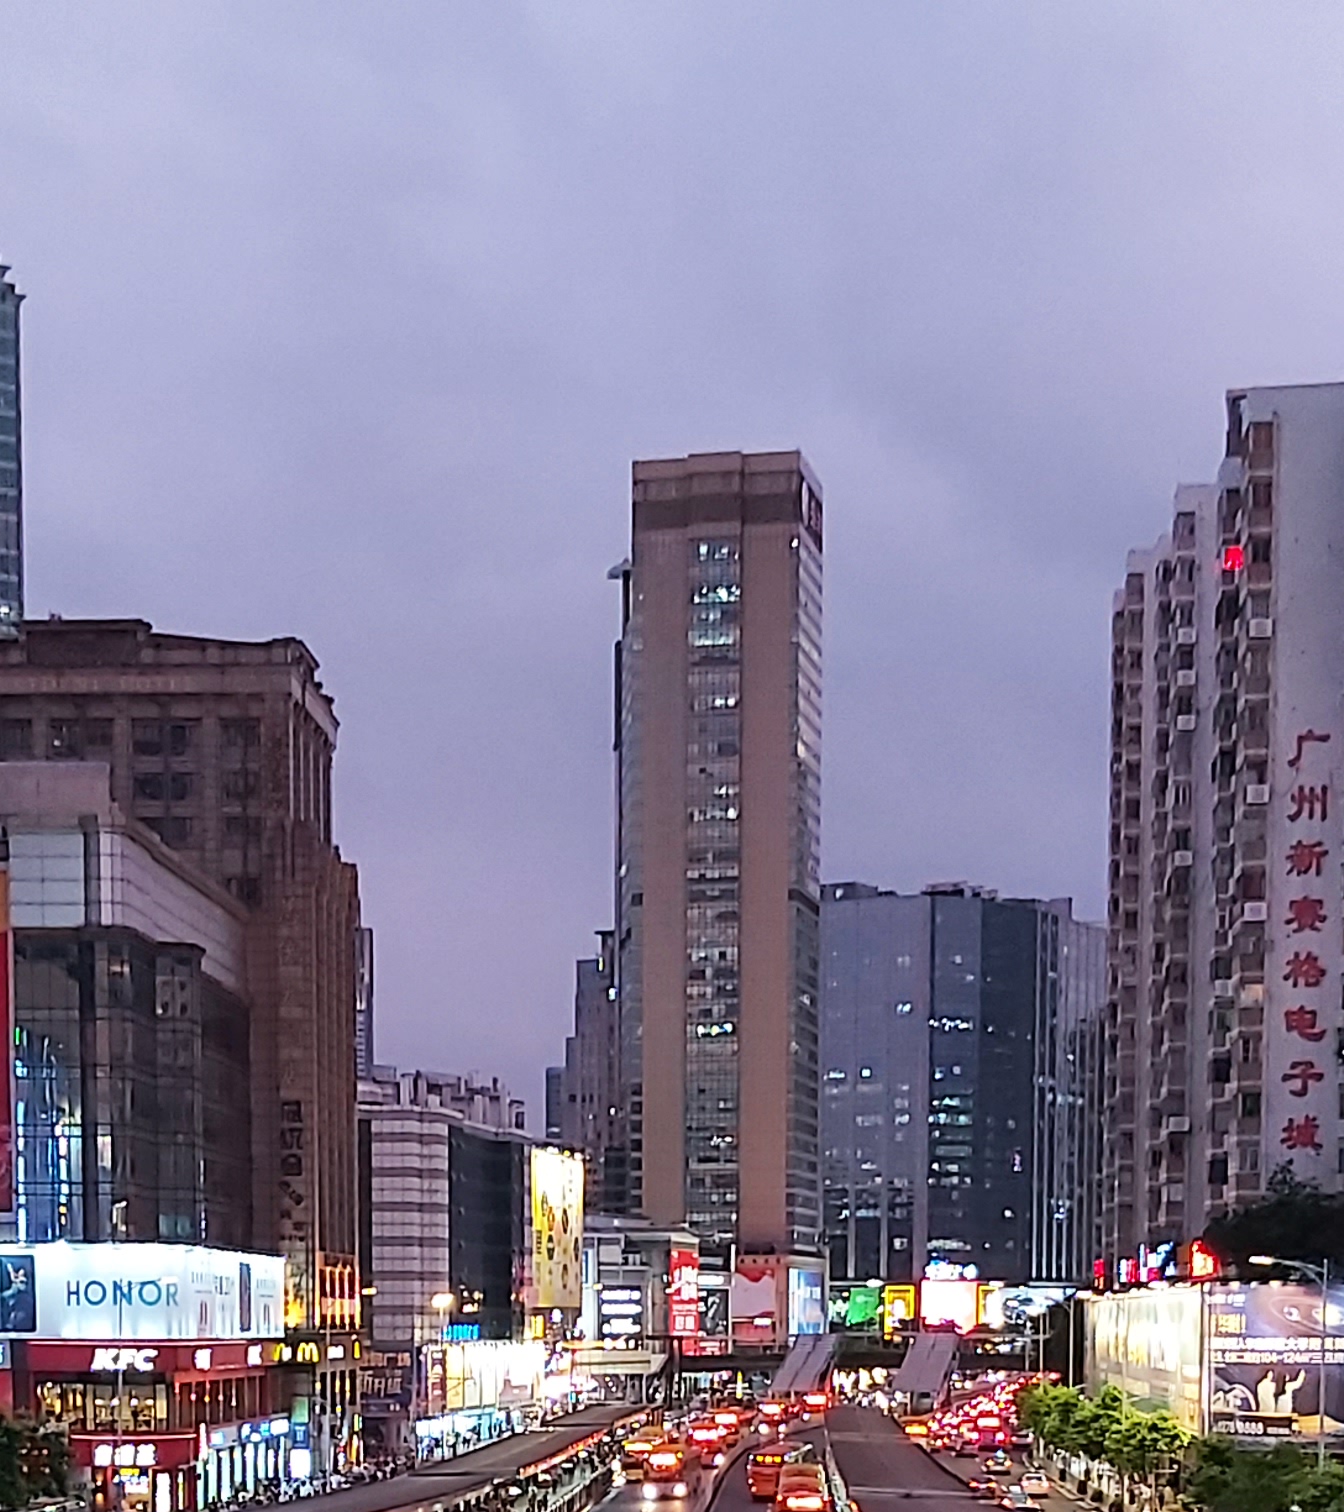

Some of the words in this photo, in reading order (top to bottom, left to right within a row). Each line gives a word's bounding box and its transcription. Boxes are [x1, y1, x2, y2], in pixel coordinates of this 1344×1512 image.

[1280, 728, 1332, 1154] 广州新赛格电子城
[65, 1278, 180, 1308] HONOR
[91, 1347, 158, 1372] KFC
